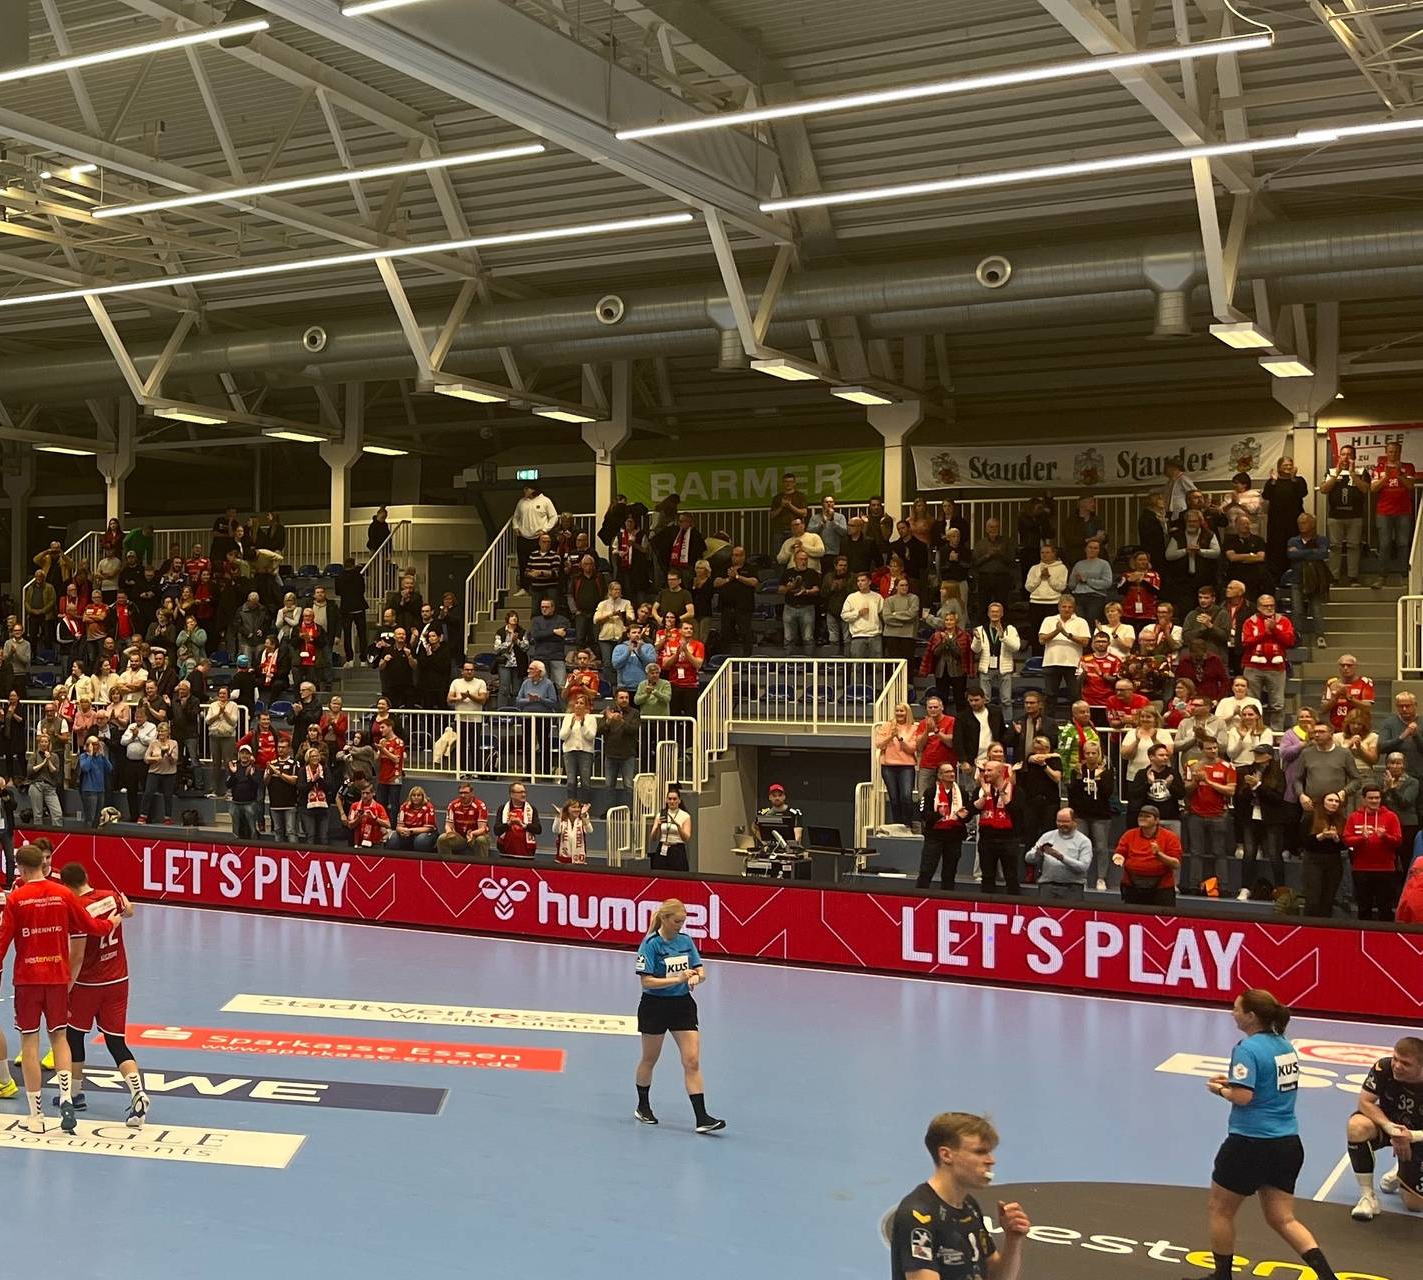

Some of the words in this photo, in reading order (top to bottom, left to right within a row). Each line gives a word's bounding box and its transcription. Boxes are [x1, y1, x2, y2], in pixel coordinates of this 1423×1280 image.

[1351, 433, 1405, 447] HILFE
[968, 454, 1058, 482] Stauder
[650, 463, 843, 502] BARMER
[143, 846, 242, 898] LET'S
[254, 855, 350, 908] PLAY
[901, 906, 1064, 975] LET'S
[1084, 920, 1245, 991] PLAY
[259, 997, 626, 1026] Stadtwerkessen
[201, 1043, 519, 1068] www.sparkasse-essen.de
[207, 1034, 397, 1053] Sparkasse
[410, 1046, 521, 1061] Essen
[1278, 1061, 1299, 1078] KÜS
[46, 1068, 330, 1103] RWE
[1397, 1094, 1415, 1115] 32
